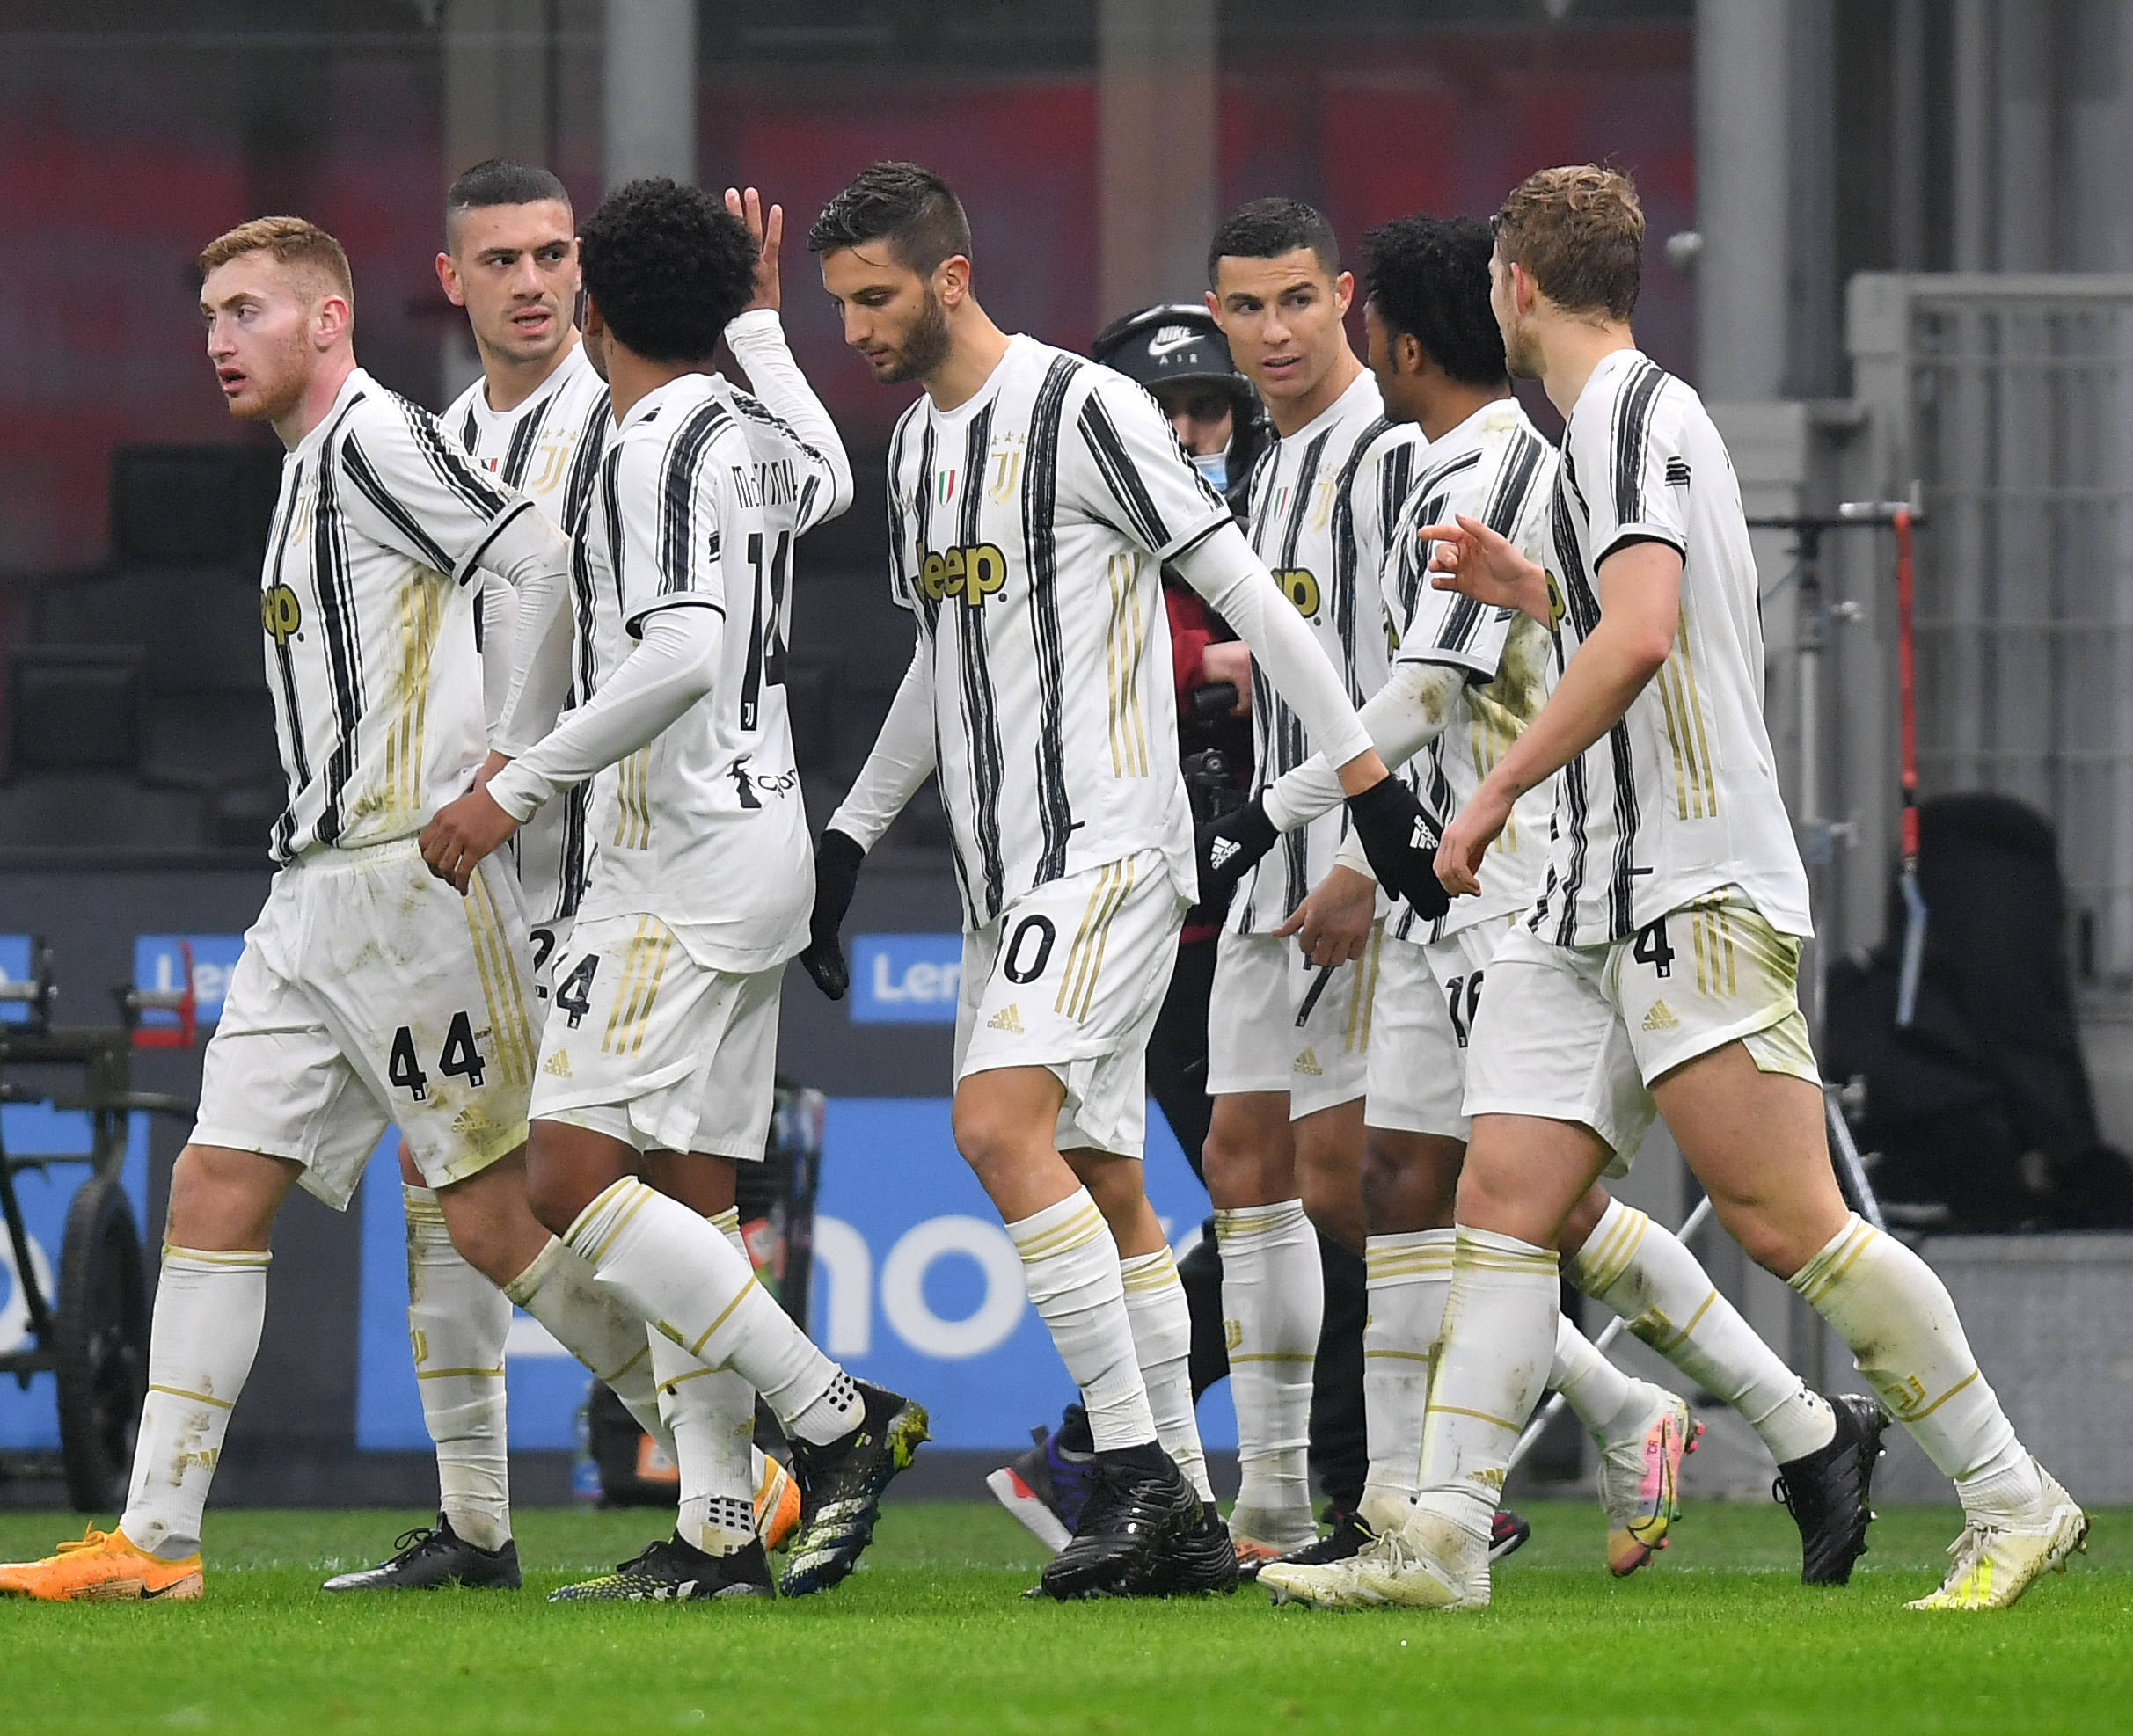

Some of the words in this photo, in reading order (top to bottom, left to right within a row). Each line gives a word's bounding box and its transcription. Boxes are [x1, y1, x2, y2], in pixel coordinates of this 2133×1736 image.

[1156, 325, 1192, 343] NIKE
[1158, 353, 1198, 366] AIR
[1633, 915, 1675, 978] 4
[873, 953, 962, 1003] Len
[388, 1010, 486, 1102] 44
